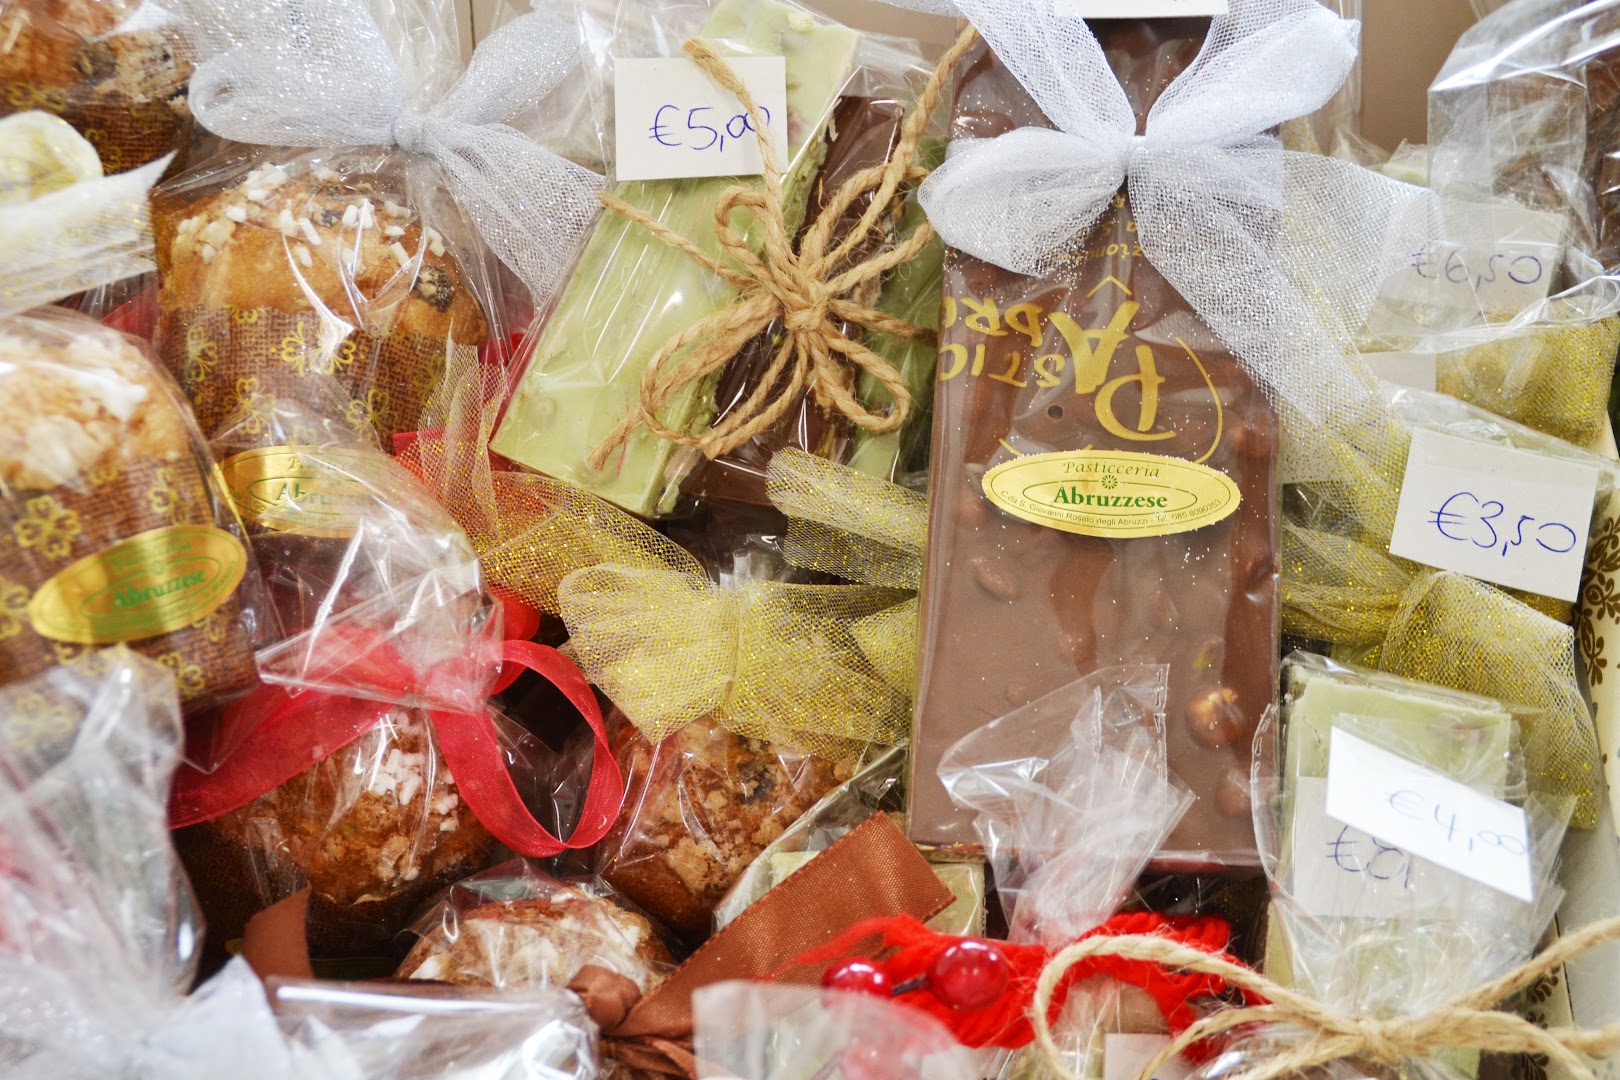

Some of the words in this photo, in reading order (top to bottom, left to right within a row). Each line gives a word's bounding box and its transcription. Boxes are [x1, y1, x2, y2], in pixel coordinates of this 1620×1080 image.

[1411, 246, 1543, 291] €6,50
[1063, 461, 1160, 478] Pasticceria
[1053, 486, 1168, 508] Abruzzese
[1030, 504, 1064, 518] Giovanni
[1096, 517, 1116, 527] degli
[1118, 517, 1149, 526] Abruzzi
[1427, 491, 1577, 557] €3,50
[1387, 789, 1526, 856] €4,00
